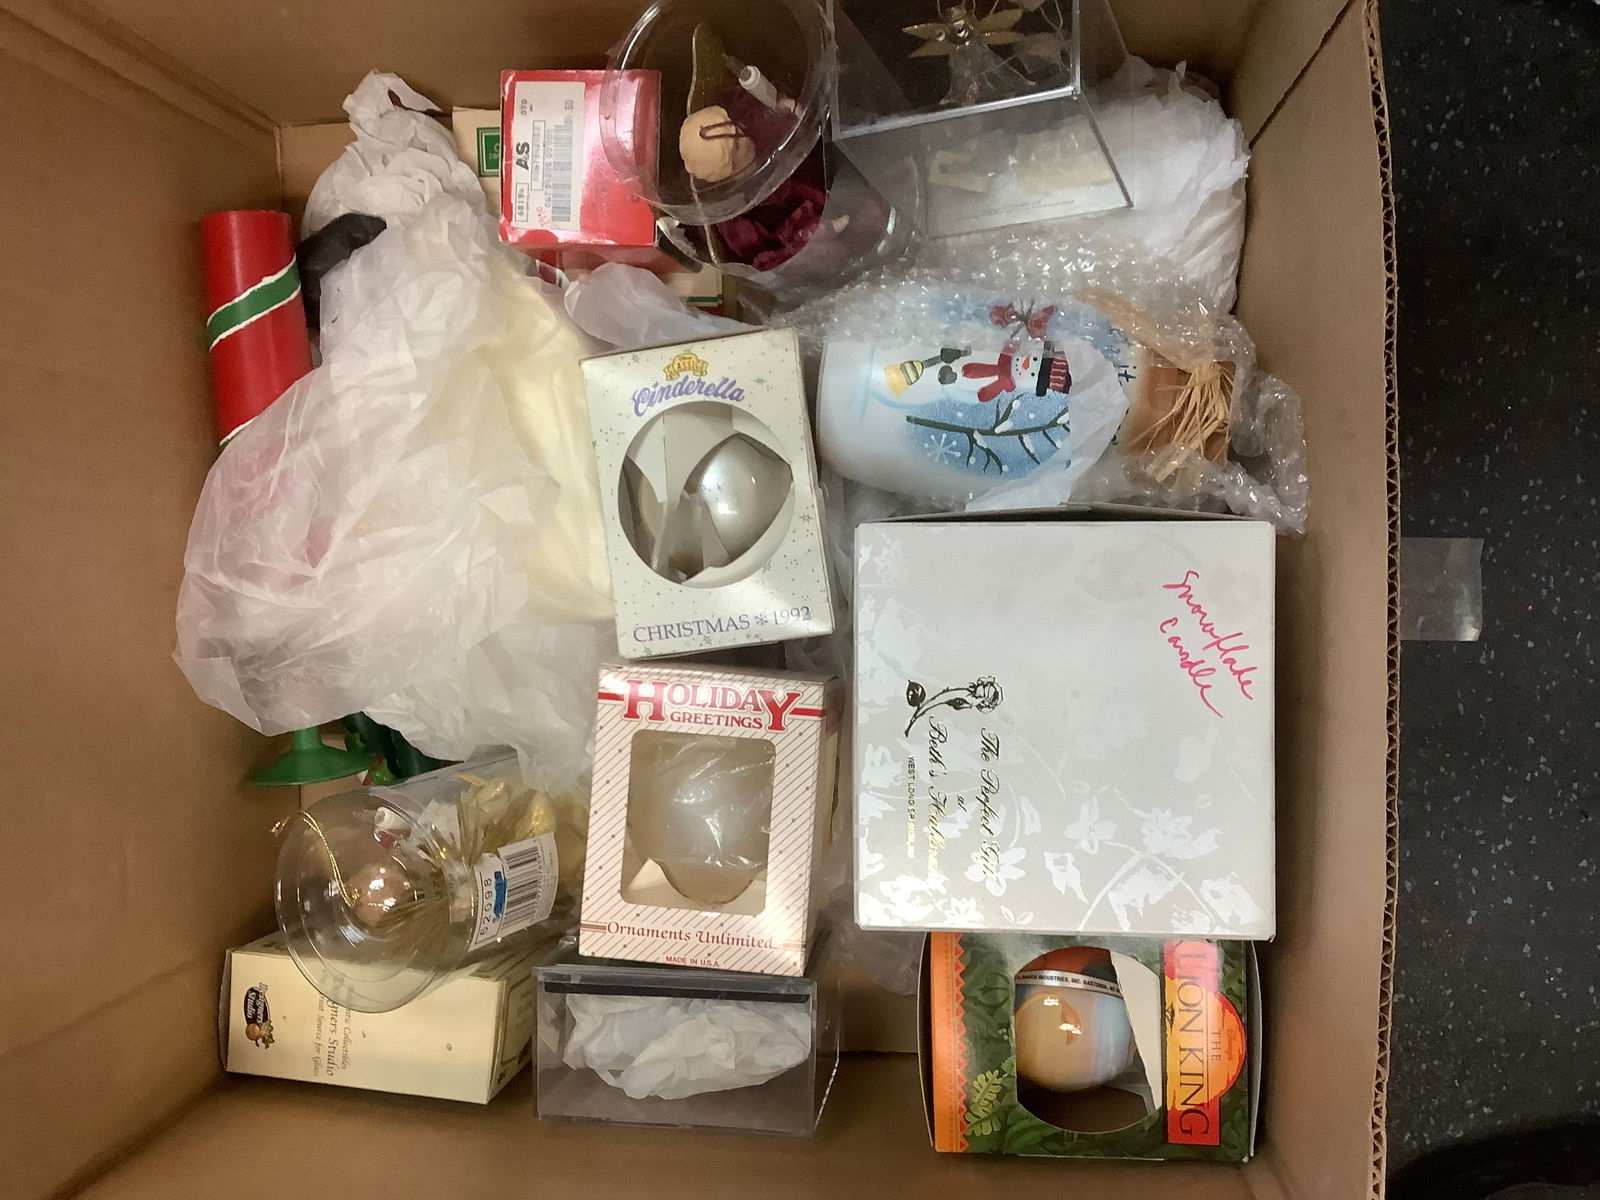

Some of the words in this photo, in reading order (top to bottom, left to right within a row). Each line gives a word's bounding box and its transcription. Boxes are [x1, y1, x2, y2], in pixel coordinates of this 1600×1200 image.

[515, 141, 530, 171] AS
[631, 375, 745, 417] Cinderella
[632, 613, 751, 644] CHRISTMAS
[770, 606, 812, 627] 1992
[623, 679, 802, 732] HOLIDAY
[670, 711, 763, 730] GREETINGS
[928, 715, 948, 777] Beth's
[980, 727, 1000, 762] The
[907, 756, 916, 780] WEST
[957, 795, 967, 812] at
[976, 769, 1000, 836] Perfect
[606, 921, 692, 942] Ornaments
[665, 956, 688, 965] MADE
[246, 990, 257, 1019] Studio
[1178, 952, 1206, 1033] LION
[326, 1000, 340, 1034] gners
[326, 1037, 340, 1077] Studio
[1211, 1029, 1222, 1062] THE
[1178, 1046, 1210, 1136] KING
